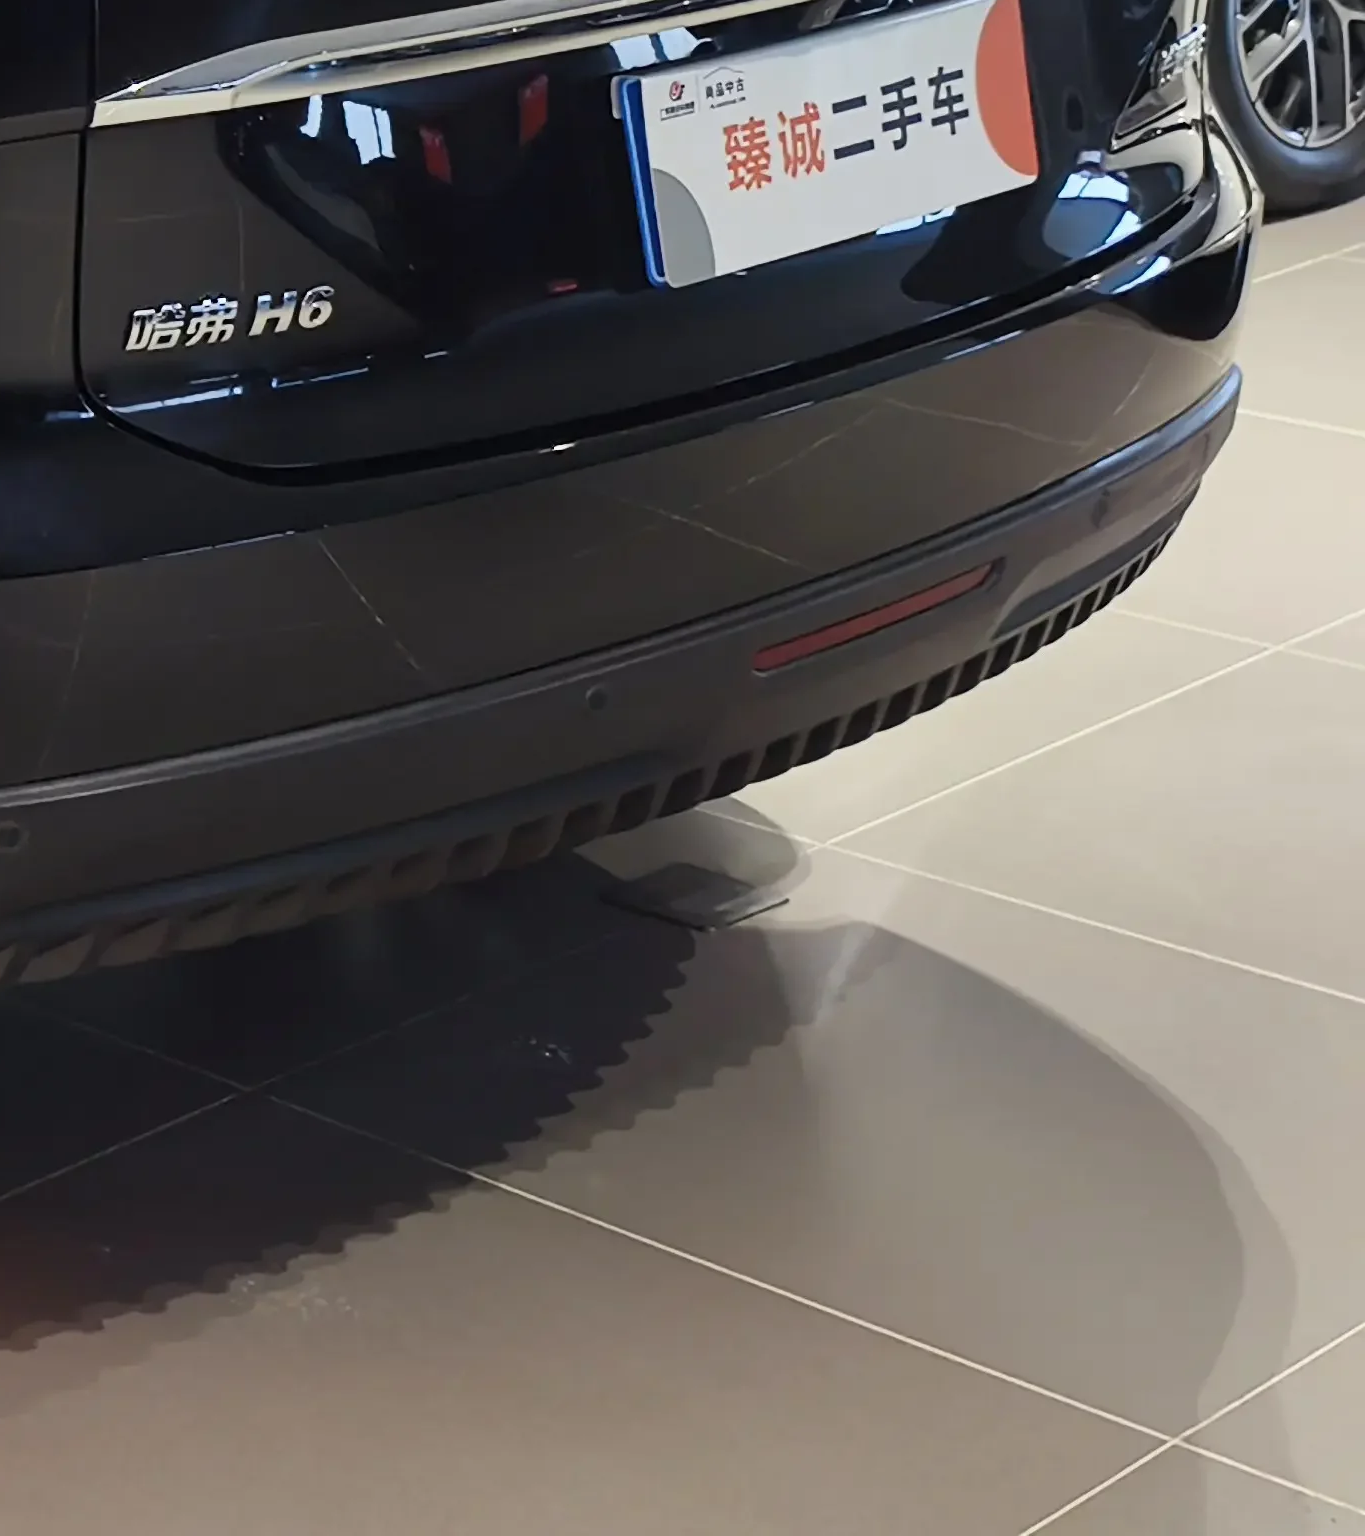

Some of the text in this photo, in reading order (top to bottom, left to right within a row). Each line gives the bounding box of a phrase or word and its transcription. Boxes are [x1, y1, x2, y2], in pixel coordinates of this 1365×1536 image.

[722, 65, 970, 192] 臻诚二手车
[125, 284, 336, 352] 哈弗 H6
